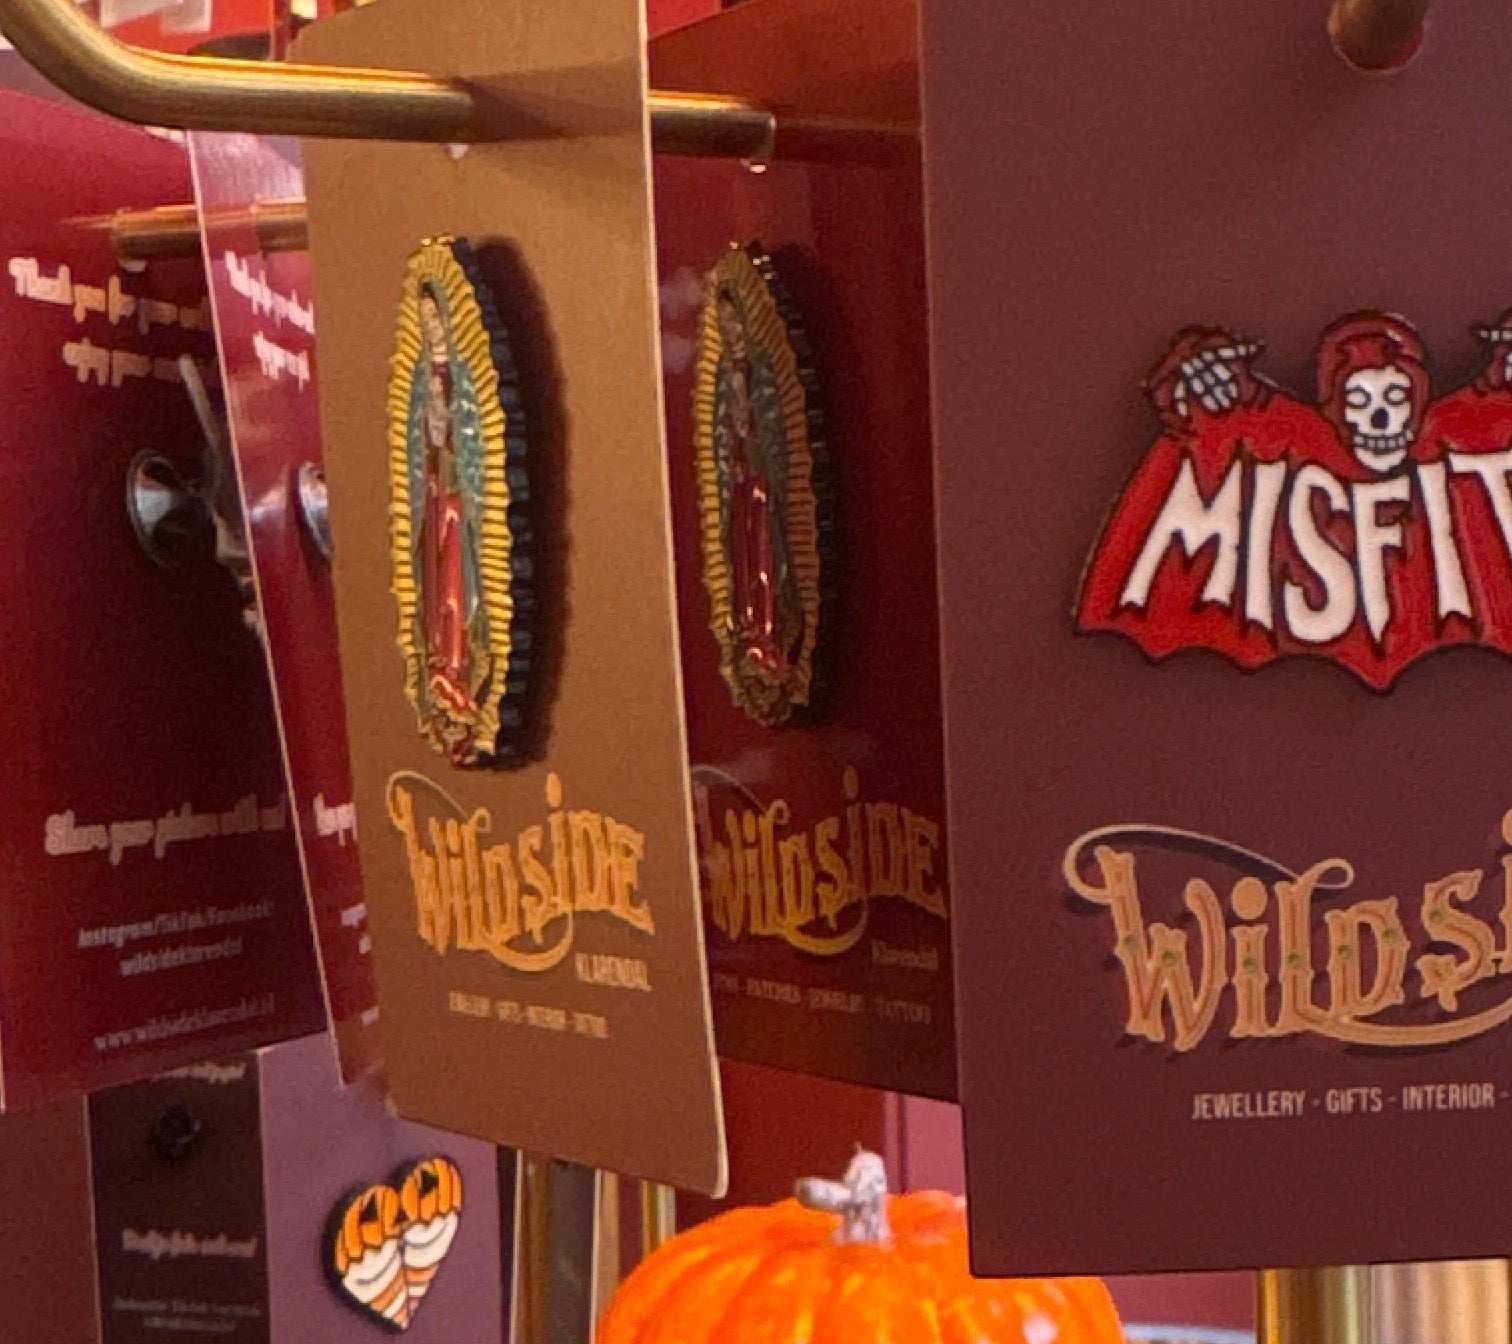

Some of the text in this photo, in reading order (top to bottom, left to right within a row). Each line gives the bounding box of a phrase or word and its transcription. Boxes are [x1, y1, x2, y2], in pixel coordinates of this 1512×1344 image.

[1192, 1091, 1306, 1121] JEWELLERY
[1326, 1086, 1383, 1115] GIFTS
[1402, 1082, 1496, 1111] INTERIOR
